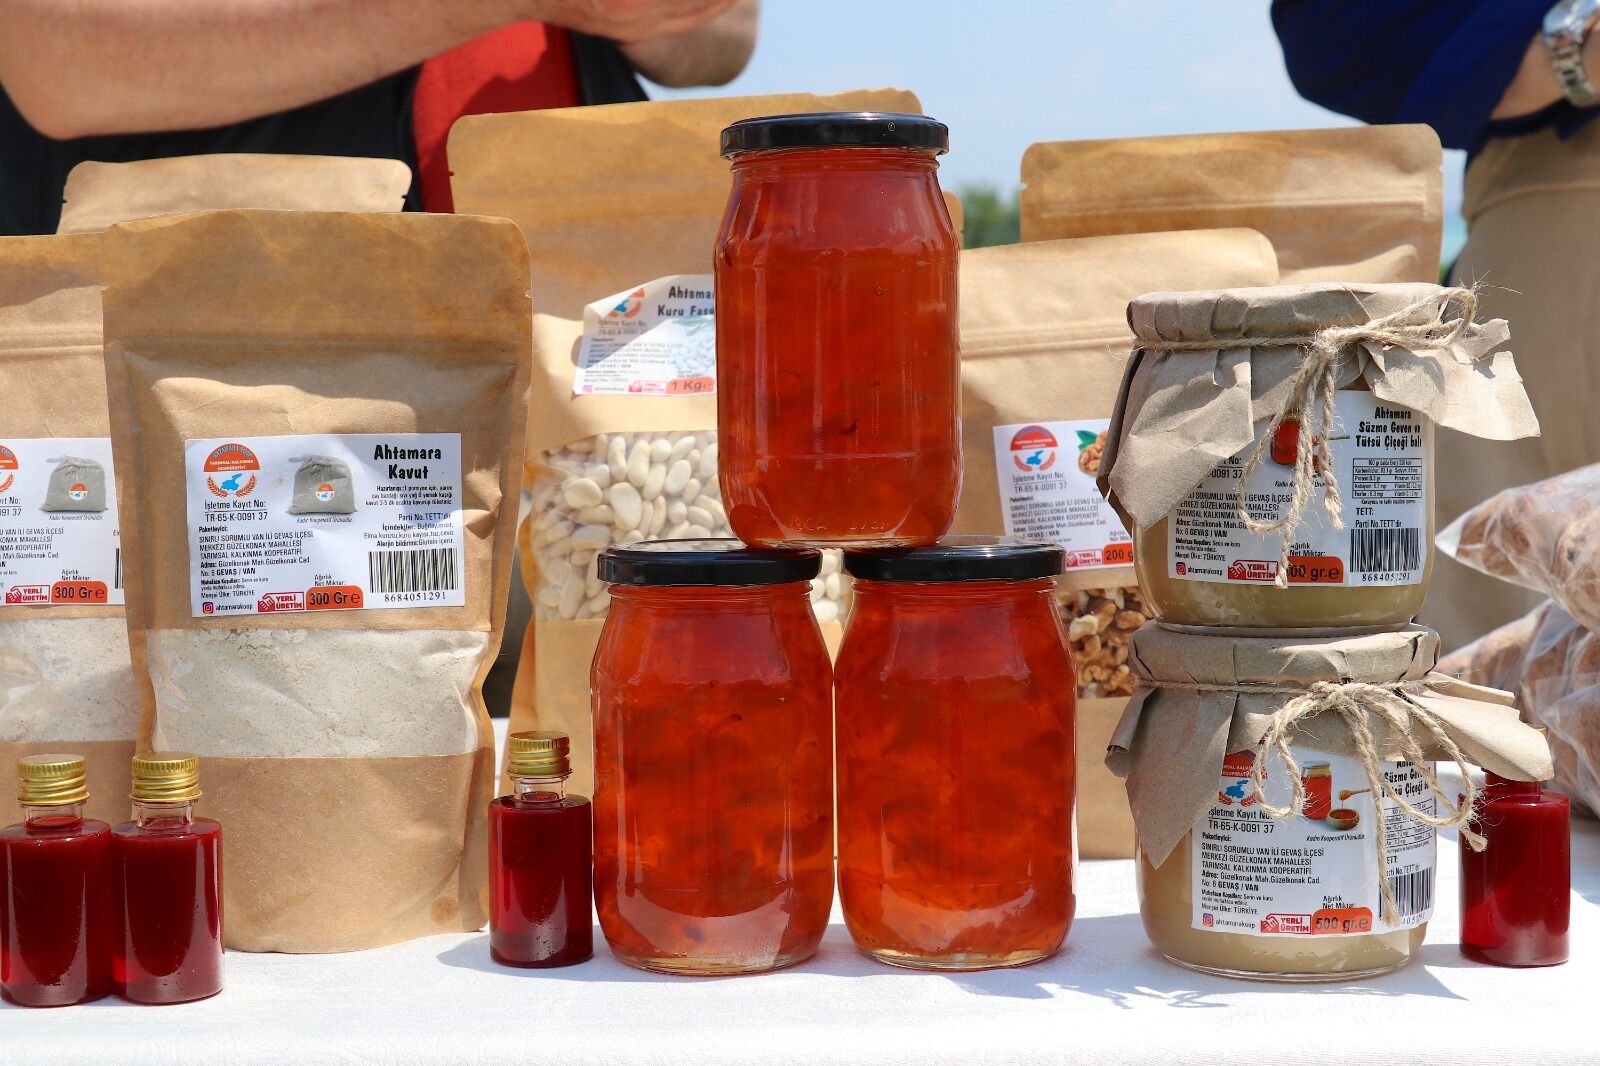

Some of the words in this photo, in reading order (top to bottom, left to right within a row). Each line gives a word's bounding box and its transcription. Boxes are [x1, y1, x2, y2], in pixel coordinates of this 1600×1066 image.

[658, 305, 684, 318] Kuru
[690, 306, 714, 317] Fasu
[672, 382, 677, 391] 1
[683, 381, 702, 392] Kg
[1374, 406, 1411, 419] Ahtamara
[1359, 421, 1387, 433] Süzme
[1390, 421, 1412, 433] Geven
[1355, 434, 1381, 448] Tütsü
[1384, 434, 1408, 451] Çiçeği
[1410, 435, 1422, 448] balı
[373, 444, 442, 461] Ahtamara
[1228, 456, 1242, 465] No:
[388, 463, 429, 480] Kavut
[1232, 469, 1243, 480] 37
[1058, 481, 1068, 490] 37
[9, 496, 21, 506] No:
[1195, 492, 1224, 502] SORUMLU
[1225, 493, 1238, 502] VAN
[1248, 494, 1270, 504] GEVAŞ
[1271, 493, 1293, 504] İLÇESİ
[204, 500, 230, 512] İşletme
[232, 499, 251, 511] Kayıt
[253, 498, 266, 508] No:
[1245, 502, 1279, 512] AHALLESİ
[12, 507, 22, 517] 37
[205, 512, 255, 524] TR-65-K-0091
[258, 511, 268, 520] 37
[398, 513, 413, 521] Parti
[1175, 508, 1202, 518] TARIMSAL
[1203, 509, 1236, 521] KALKINMA
[1355, 507, 1374, 516] TETT:
[1355, 519, 1370, 529] Parti
[4, 528, 17, 537] VAN
[45, 526, 65, 537] İLÇESİ
[199, 535, 220, 544] SINIRLI
[221, 533, 251, 543] SORUMLU
[252, 533, 265, 541] VAN
[294, 530, 314, 541] İLÇESİ
[1189, 528, 1209, 540] GEVAŞ
[1213, 529, 1228, 539] VAN
[19, 535, 53, 544] MAHALLESİ
[199, 542, 225, 552] MERKEZİ
[226, 540, 267, 550] GÜZELKONAK
[268, 538, 302, 548] MAHALLESİ
[376, 540, 395, 548] Alerjin
[15, 542, 52, 552] KOOPERATİFİ
[200, 551, 229, 560] TARIMSAL
[230, 550, 263, 559] KALKINMA
[264, 547, 302, 557] KOOPERATİFİ
[1106, 549, 1125, 561] 200
[1128, 551, 1134, 563] g
[218, 559, 250, 569] Güzelkonak
[298, 556, 312, 564] Cad.
[1247, 563, 1270, 572] YERLİ
[216, 568, 238, 578] GEVAŞ
[242, 567, 256, 575] VAN
[1247, 570, 1277, 580] ÜRETİM
[22, 587, 43, 596] YERLİ
[54, 586, 75, 600] 300
[78, 586, 93, 599] Gr
[233, 589, 256, 598] TÜRKİYE
[384, 591, 446, 603] 8684051291
[22, 594, 48, 602] ÜRETİM
[275, 594, 297, 603] YERLİ
[309, 592, 329, 606] 300
[333, 592, 348, 605] Gr
[275, 602, 302, 611] ÜRETİM
[1405, 780, 1424, 799] Çiçeği
[1236, 808, 1257, 821] Kayıt
[1208, 819, 1260, 833] TR-65-K-0091
[1263, 824, 1275, 835] 37
[1201, 842, 1223, 853] SINIRLI
[1223, 844, 1255, 855] SORUMLU
[1256, 847, 1270, 857] VAN
[1270, 846, 1279, 856] İLİ
[1280, 848, 1302, 859] GEVAŞ
[1303, 846, 1325, 858] İLÇESİ
[1201, 851, 1228, 864] MERKEZİ
[1229, 854, 1272, 866] GÜZELKONAK
[1273, 856, 1312, 868] MAHALLESİ
[1201, 860, 1231, 872] TARIMSAL
[1233, 863, 1268, 875] KALKINMA
[1269, 865, 1312, 878] KOOPERATİFİ
[1201, 870, 1219, 881] Adres:
[1220, 872, 1253, 884] Güzelkonak
[1255, 874, 1306, 886] Mah.Güzelkonak
[1217, 881, 1239, 892] GEVAŞ
[1244, 883, 1259, 893] VAN
[1233, 906, 1259, 917] TÜRKİYE
[1280, 916, 1303, 926] YERLİ
[1315, 917, 1339, 931] 500
[1280, 923, 1310, 934] ÜRETİM
